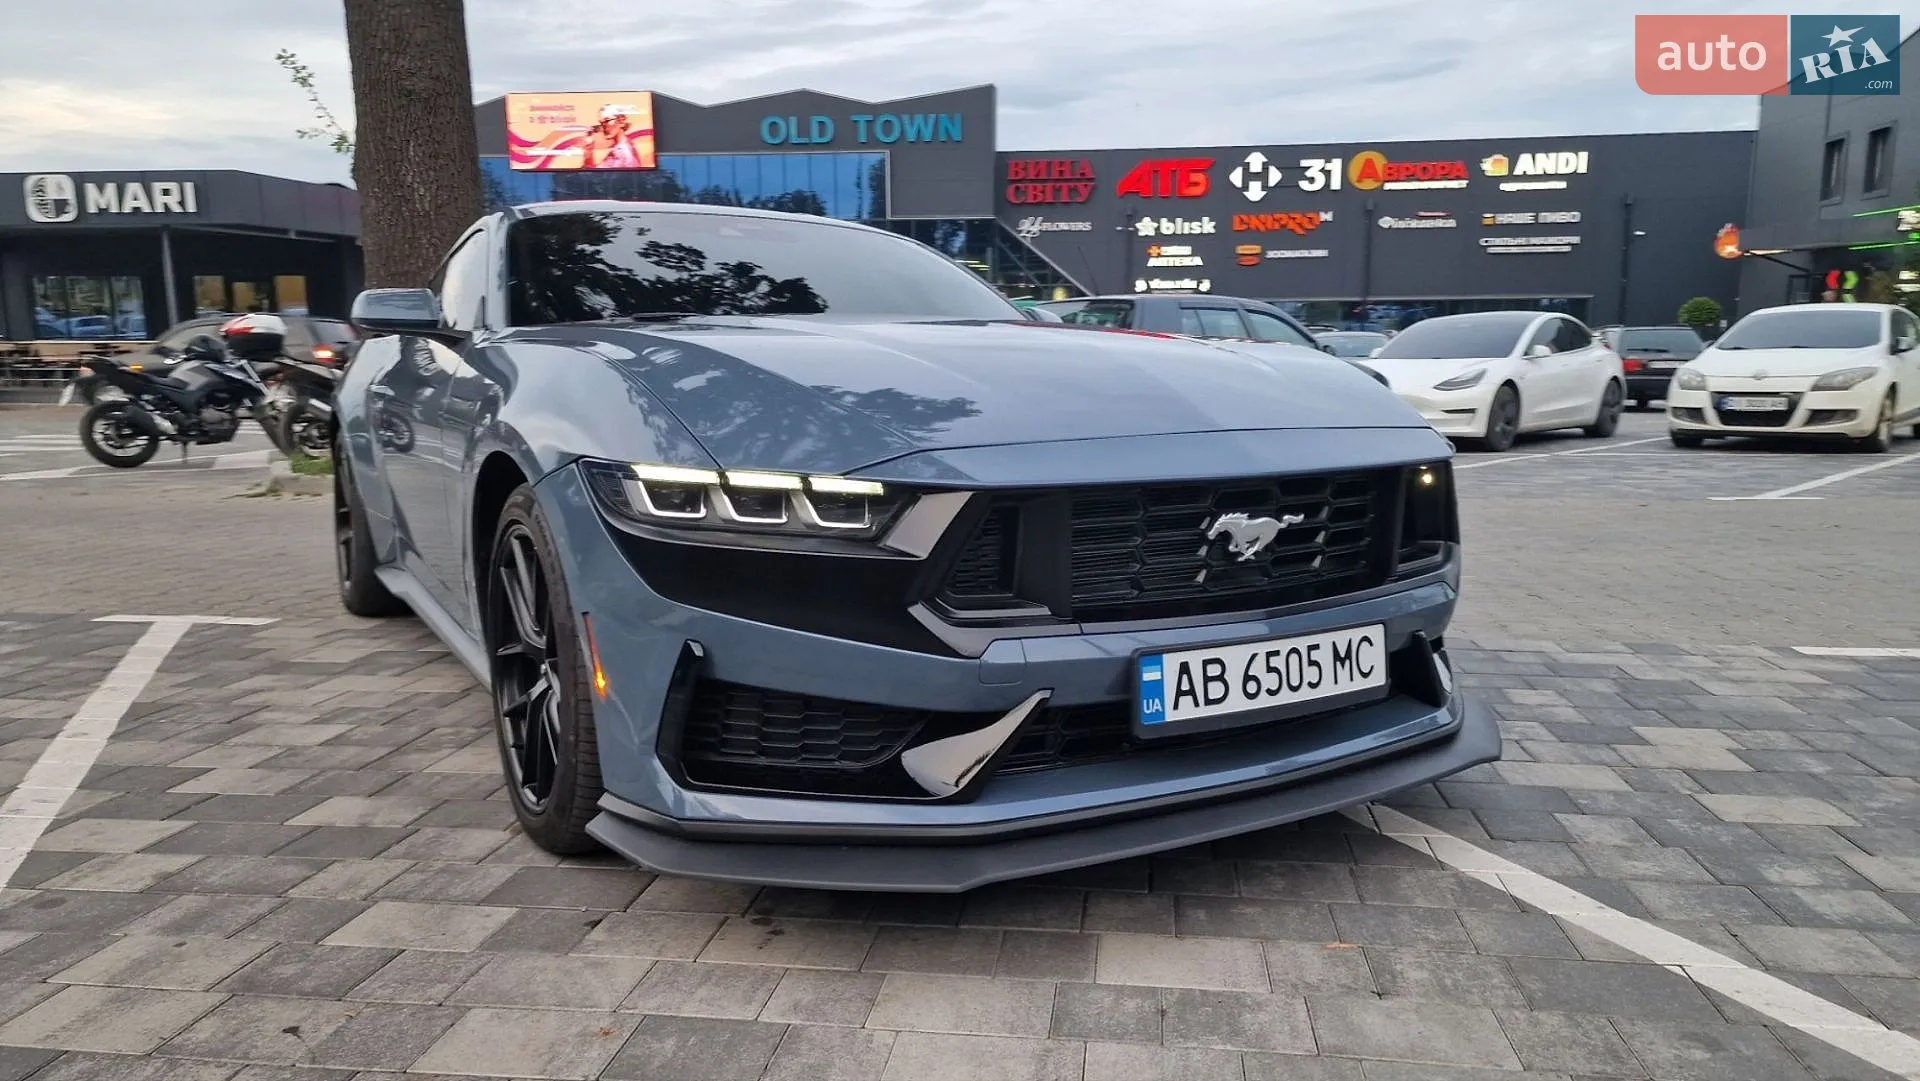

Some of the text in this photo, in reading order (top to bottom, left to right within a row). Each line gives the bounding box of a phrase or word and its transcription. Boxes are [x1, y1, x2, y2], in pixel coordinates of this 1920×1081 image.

[760, 113, 963, 144] OLD TOWN
[1007, 160, 1095, 180] ВИНА
[1298, 158, 1343, 191] 31
[1356, 158, 1469, 182] АВРОРА
[1513, 152, 1589, 175] ANDI
[1116, 158, 1215, 198] АТБ
[84, 182, 197, 213] MARI
[1007, 182, 1095, 204] СВІТУ
[1159, 216, 1216, 235] blisk
[1173, 635, 1374, 711] AB 6505 MC
[1143, 698, 1162, 713] UA
